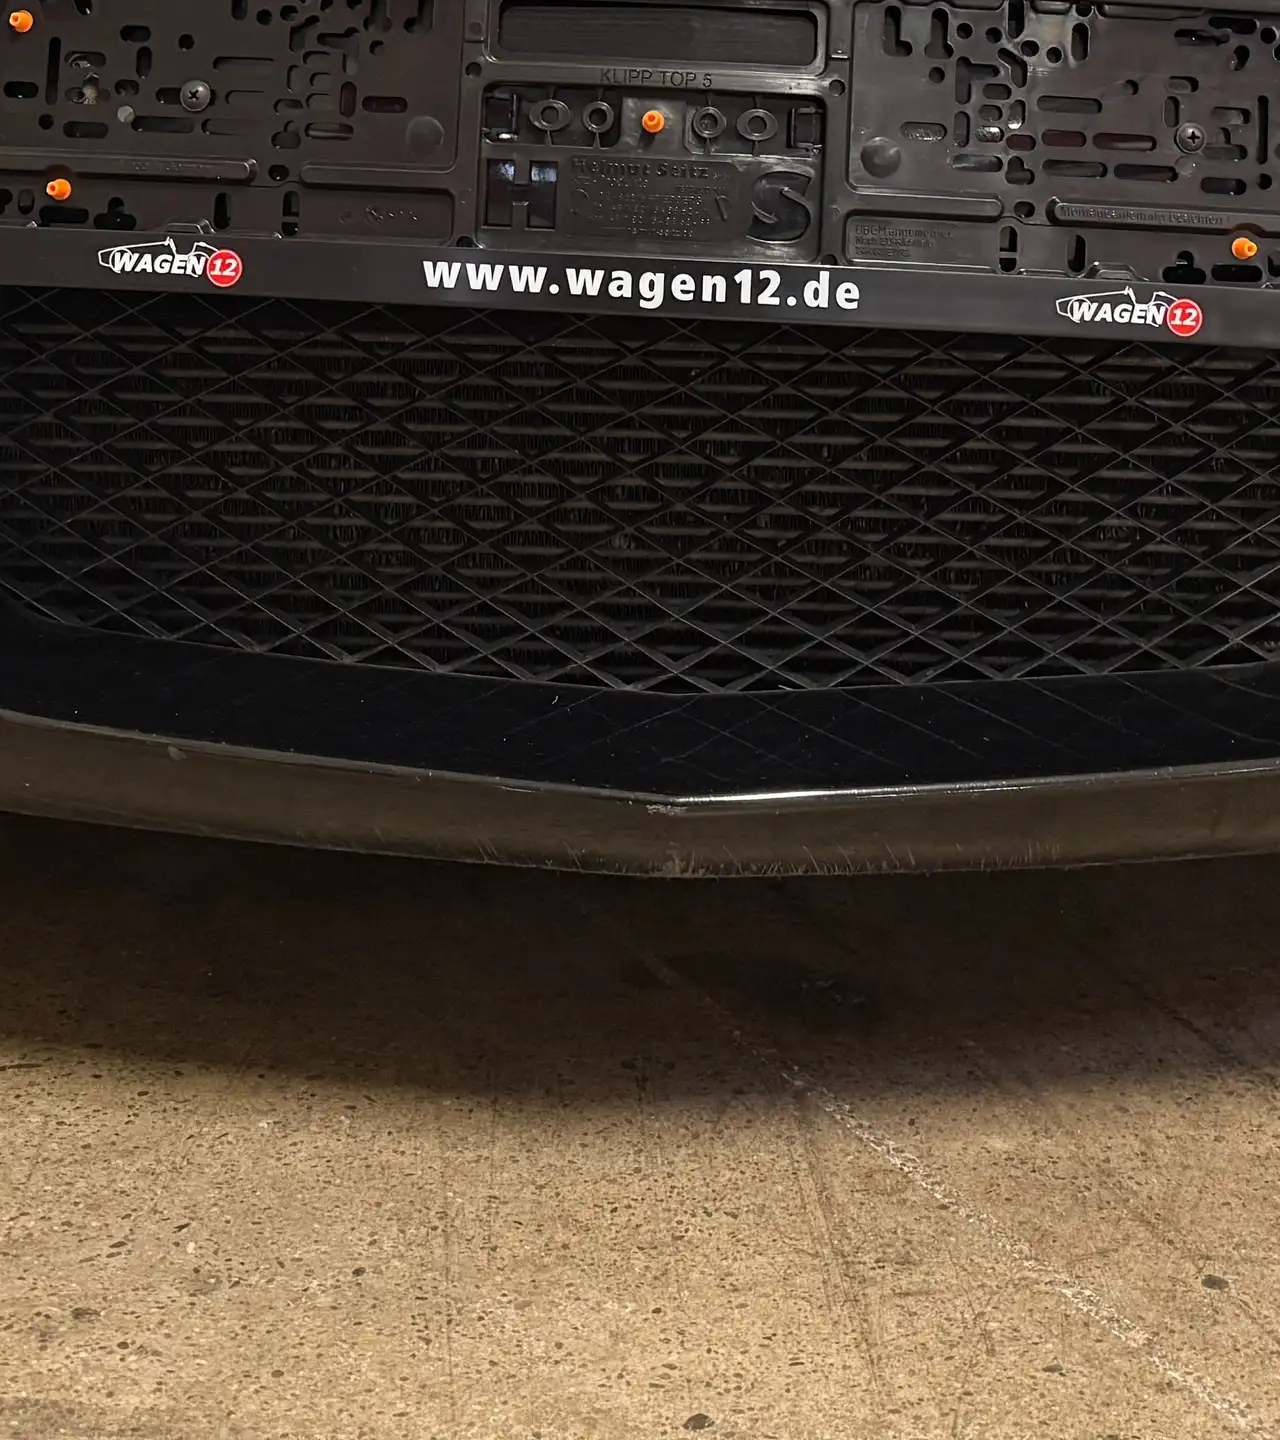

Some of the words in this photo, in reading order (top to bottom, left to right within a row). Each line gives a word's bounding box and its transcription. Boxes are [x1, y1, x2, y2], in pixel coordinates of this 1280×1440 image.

[600, 67, 653, 85] KLIPP
[658, 70, 697, 88] TOP
[702, 72, 713, 88] 5
[114, 251, 207, 277] WAGEN
[210, 258, 238, 276] 12
[422, 260, 861, 310] www.wagen12.de
[1072, 301, 1166, 326] WAGEN
[1170, 307, 1198, 326] 12
